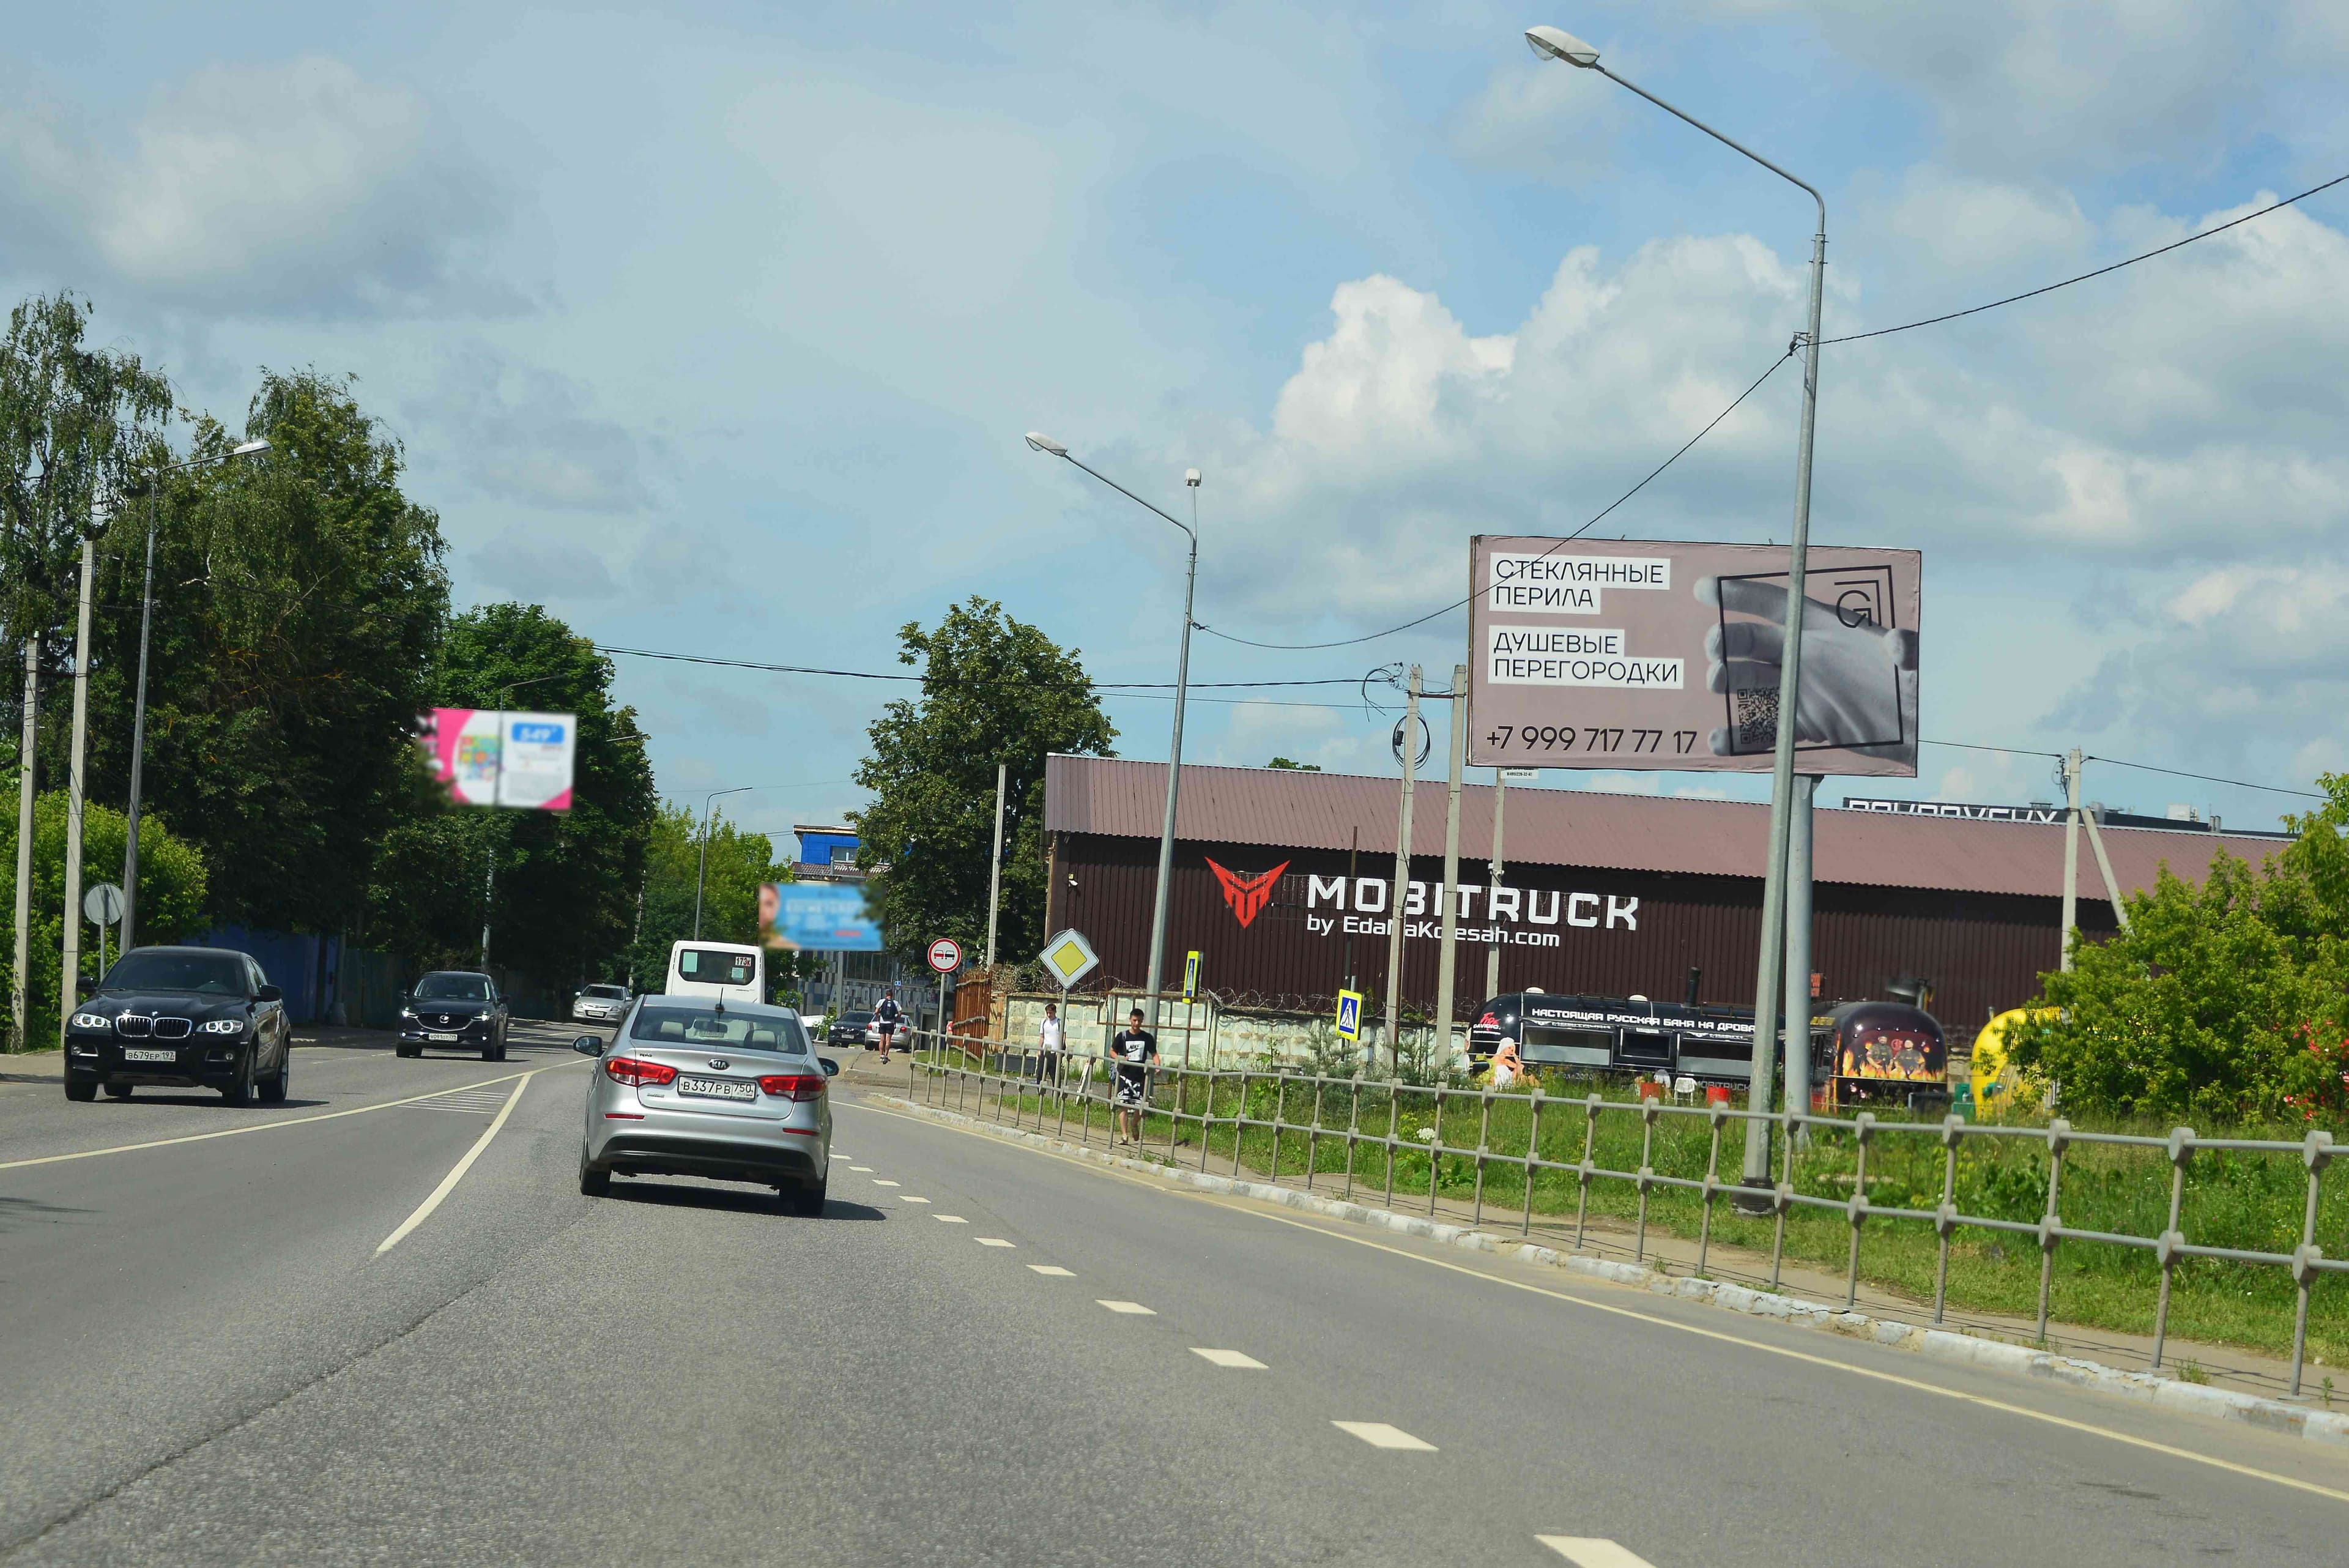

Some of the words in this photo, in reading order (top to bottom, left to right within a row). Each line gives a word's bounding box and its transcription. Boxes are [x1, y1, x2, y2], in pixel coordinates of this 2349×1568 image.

[1496, 559, 1664, 583] СТЕКЛЯННЫЕ
[1496, 585, 1594, 608] ПЕРИЛА
[1493, 632, 1618, 654] ДУШЕВЫЕ
[1494, 658, 1677, 684] ПЕРЕГОРОДКИ
[1486, 726, 1513, 749] +7
[1521, 726, 1576, 751] 999
[1584, 728, 1624, 752] 717
[1631, 729, 1663, 752] 77
[1673, 730, 1698, 754] 17
[1307, 874, 1638, 931] MOBITRUCK
[1307, 914, 1335, 936] by
[1532, 1008, 1604, 1021] НАСТОЯЩАЯ
[1606, 1014, 1660, 1026] РУССКАЯ
[1663, 1019, 1695, 1028] БАНЯ
[711, 1060, 727, 1069] KIA
[683, 1079, 732, 1094] В337РВ
[734, 1083, 752, 1093] 750
